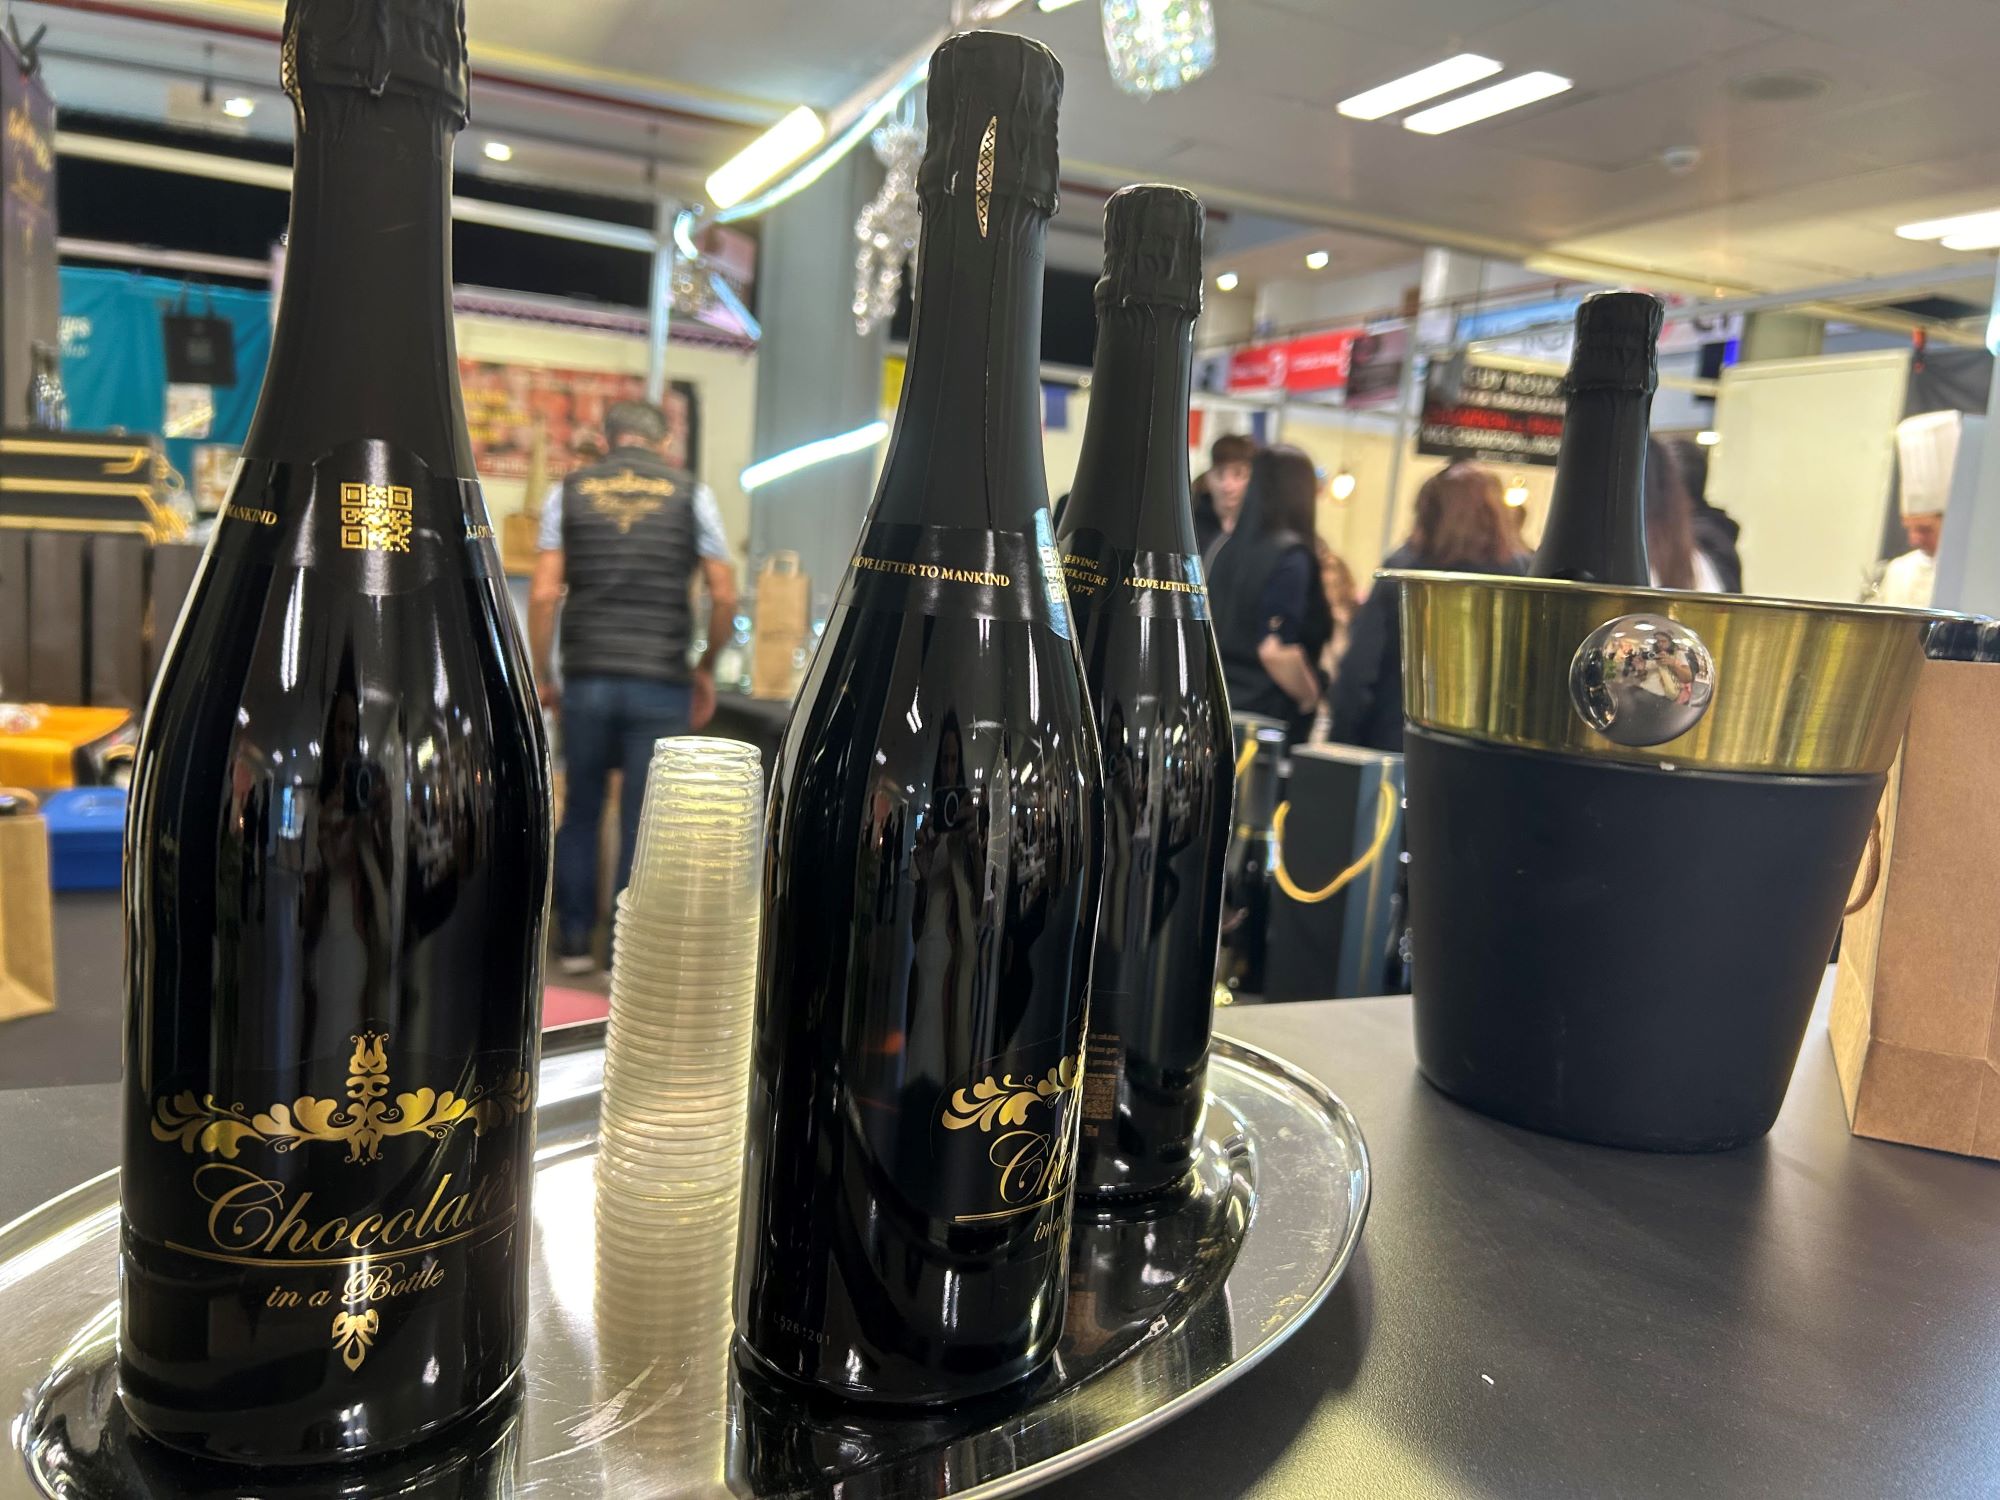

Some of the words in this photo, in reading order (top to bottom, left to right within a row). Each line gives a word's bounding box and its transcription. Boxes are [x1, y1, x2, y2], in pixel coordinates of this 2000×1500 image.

[1063, 554, 1099, 570] SERVING
[874, 560, 916, 576] LETTER
[919, 564, 939, 578] TO
[941, 567, 1010, 587] MANKIND
[1123, 577, 1130, 586] A
[1132, 577, 1159, 589] LOVE
[1160, 580, 1191, 593] LETTER
[266, 1285, 303, 1308] in
[308, 1288, 333, 1306] a
[341, 1259, 446, 1305] Bottle
